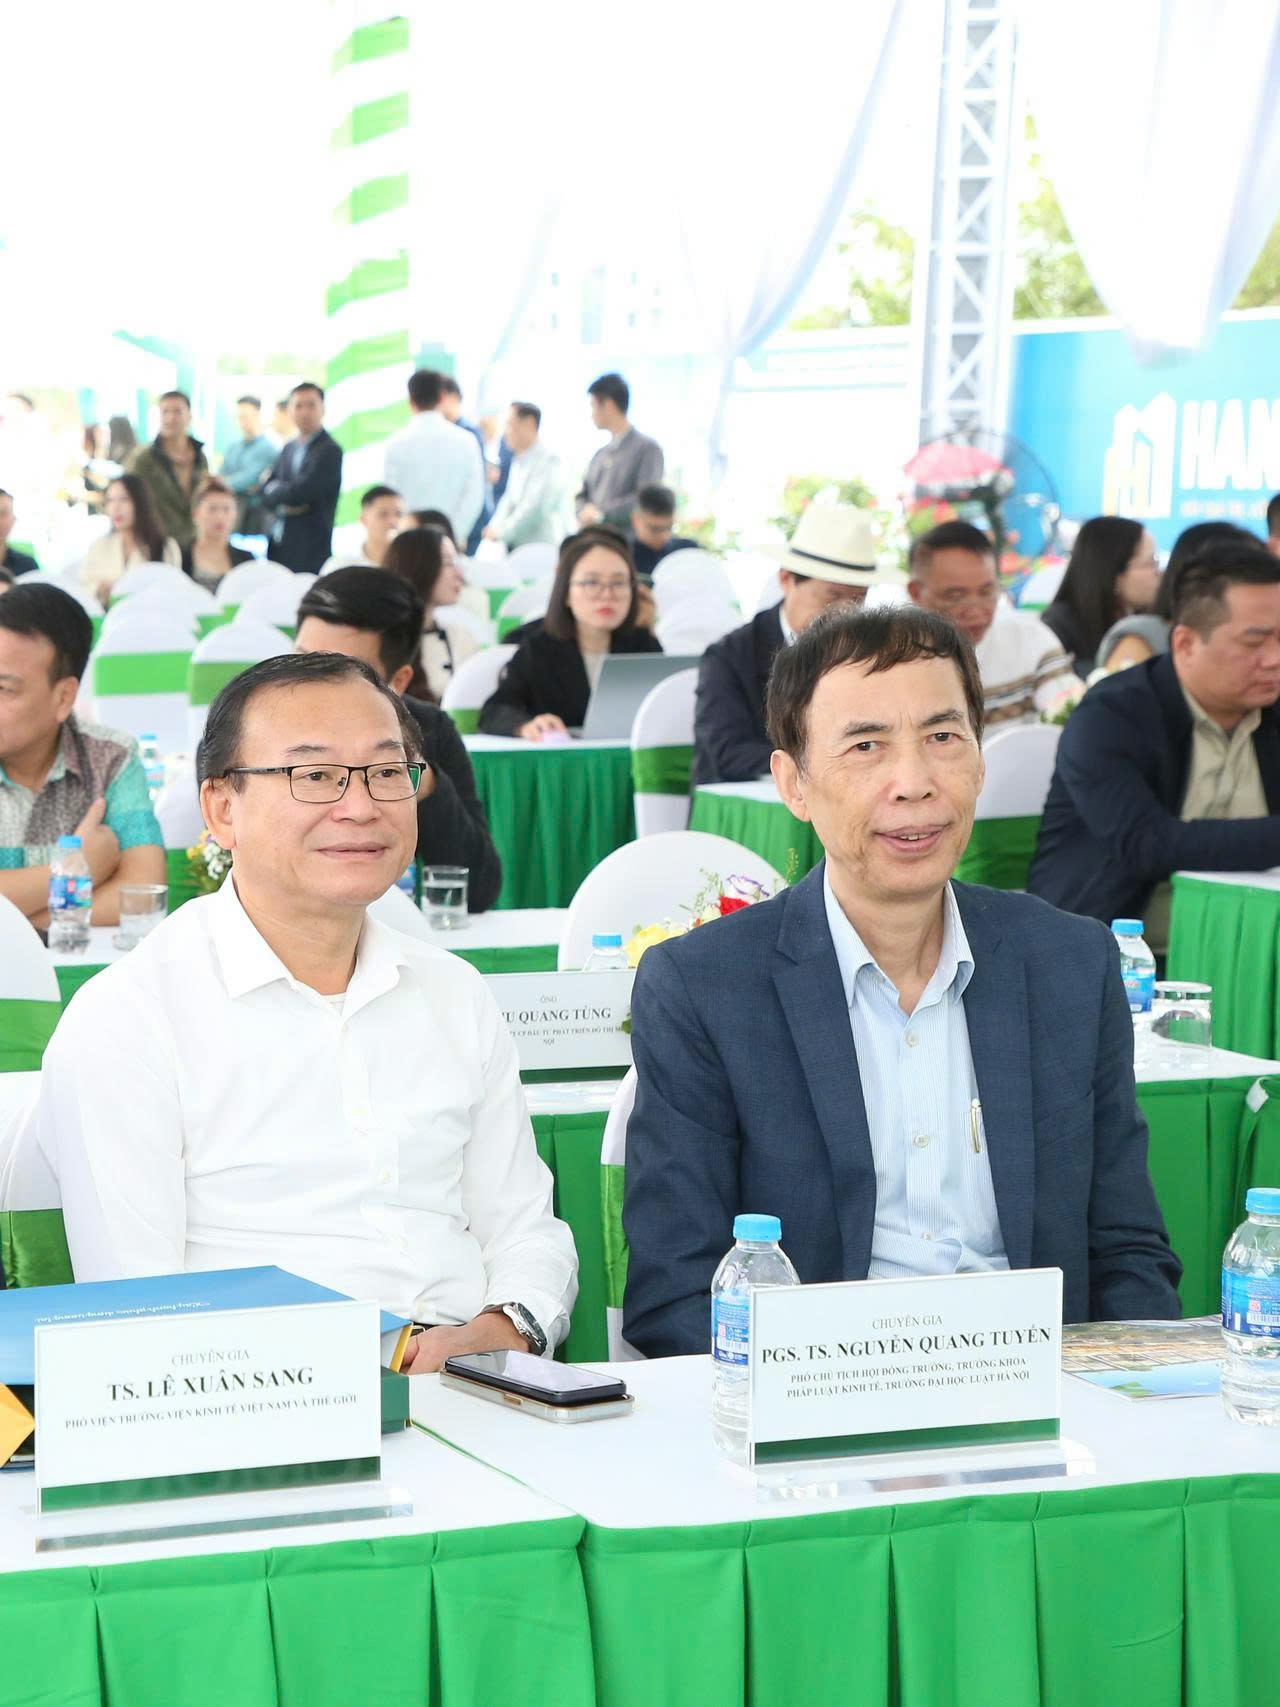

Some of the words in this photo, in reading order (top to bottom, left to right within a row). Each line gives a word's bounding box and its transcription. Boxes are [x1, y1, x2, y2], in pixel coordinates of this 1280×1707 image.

[519, 1010, 569, 1024] QUANG
[872, 1316, 920, 1330] CHUYÊN
[922, 1315, 943, 1326] GIA
[762, 1346, 801, 1363] PGS.
[806, 1344, 832, 1360] TS.
[837, 1334, 914, 1357] NGUYỄN
[920, 1333, 985, 1353] QUANG
[990, 1324, 1051, 1346] TUYẾN
[172, 1350, 225, 1366] CHUYÊN
[228, 1349, 251, 1361] GIA
[836, 1369, 859, 1380] TỊCH
[862, 1367, 880, 1378] HỘI
[999, 1358, 1026, 1367] KHOA
[107, 1383, 139, 1402] TS.
[147, 1374, 176, 1398] LÊ
[183, 1370, 247, 1394] XUÂN
[253, 1367, 313, 1388] SANG
[787, 1386, 812, 1398] PHÁP
[814, 1384, 840, 1396] LUẬT
[842, 1383, 868, 1393] KINH
[928, 1377, 945, 1388] ĐẠI
[948, 1374, 968, 1386] HỌC
[970, 1373, 995, 1384] LUẬT
[997, 1371, 1011, 1381] HÀ
[1013, 1370, 1030, 1381] NỘI
[195, 1406, 222, 1416] KINH
[267, 1400, 291, 1410] NAM
